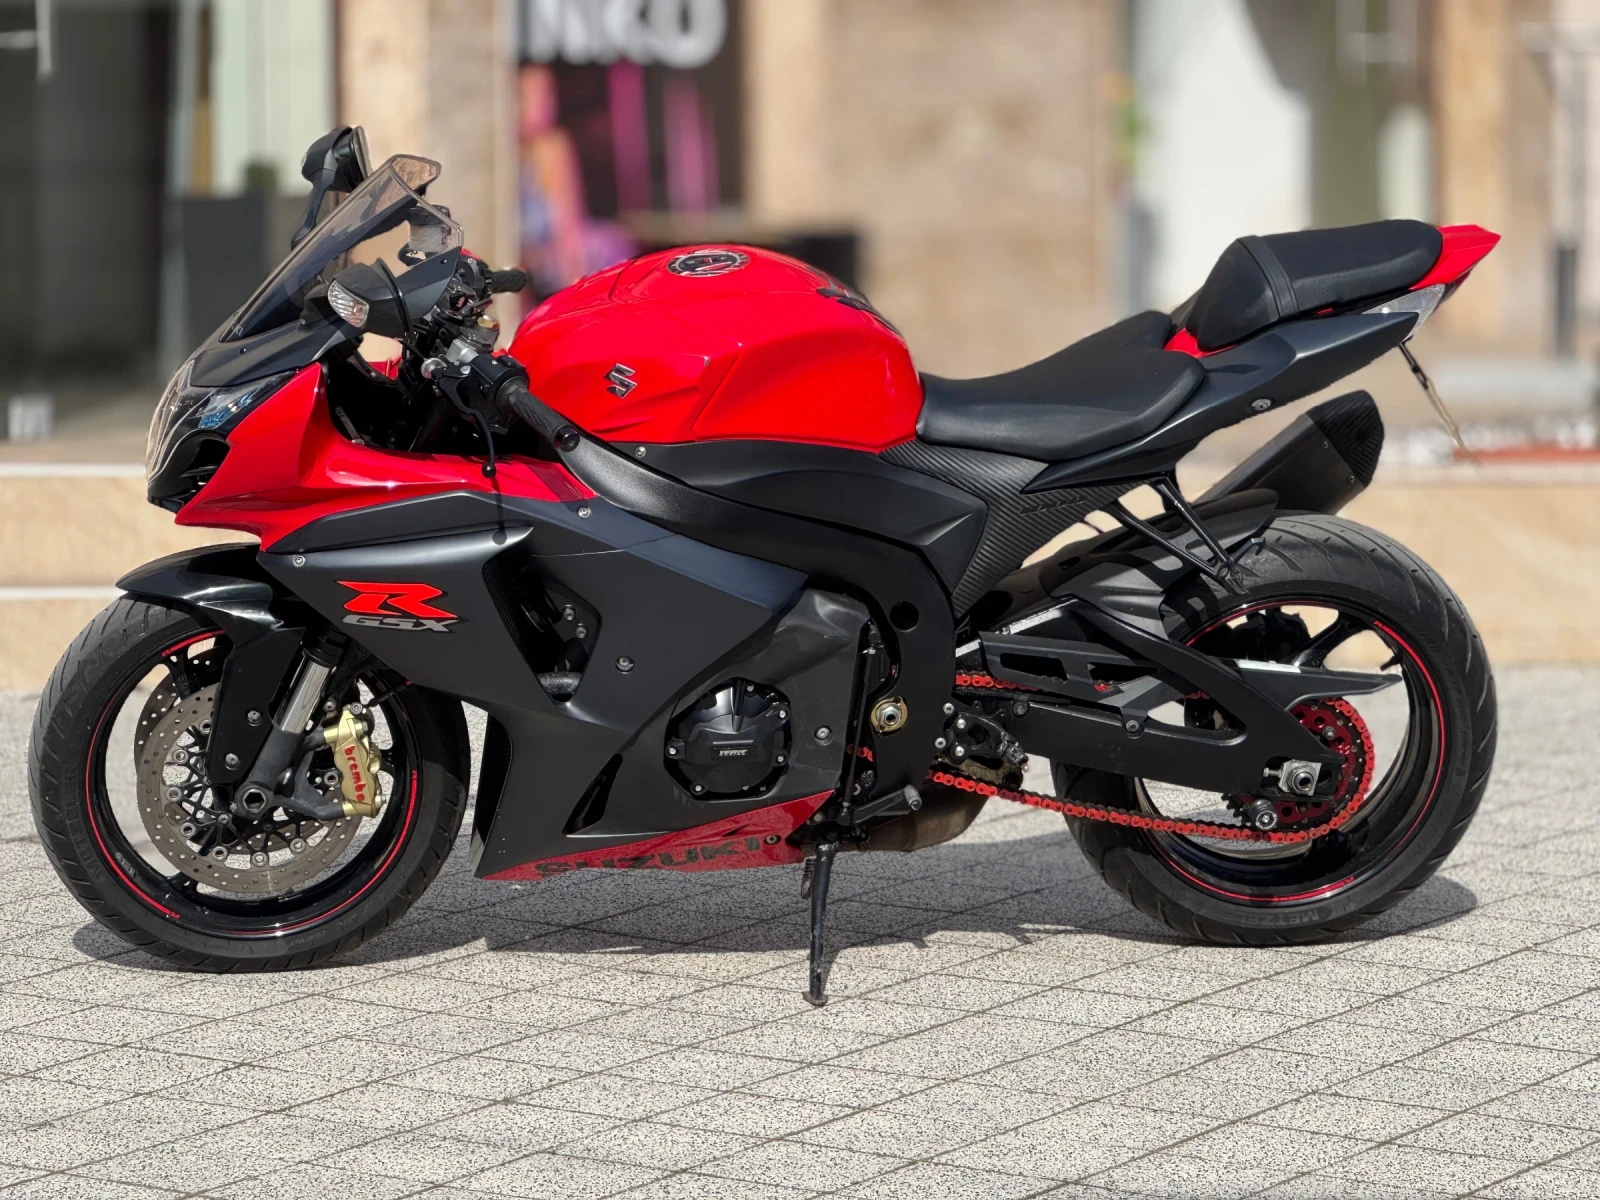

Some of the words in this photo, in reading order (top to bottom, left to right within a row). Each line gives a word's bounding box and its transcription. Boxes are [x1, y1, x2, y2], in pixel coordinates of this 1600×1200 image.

[334, 580, 460, 618] R
[342, 614, 459, 632] GSX
[344, 745, 367, 802] brembo
